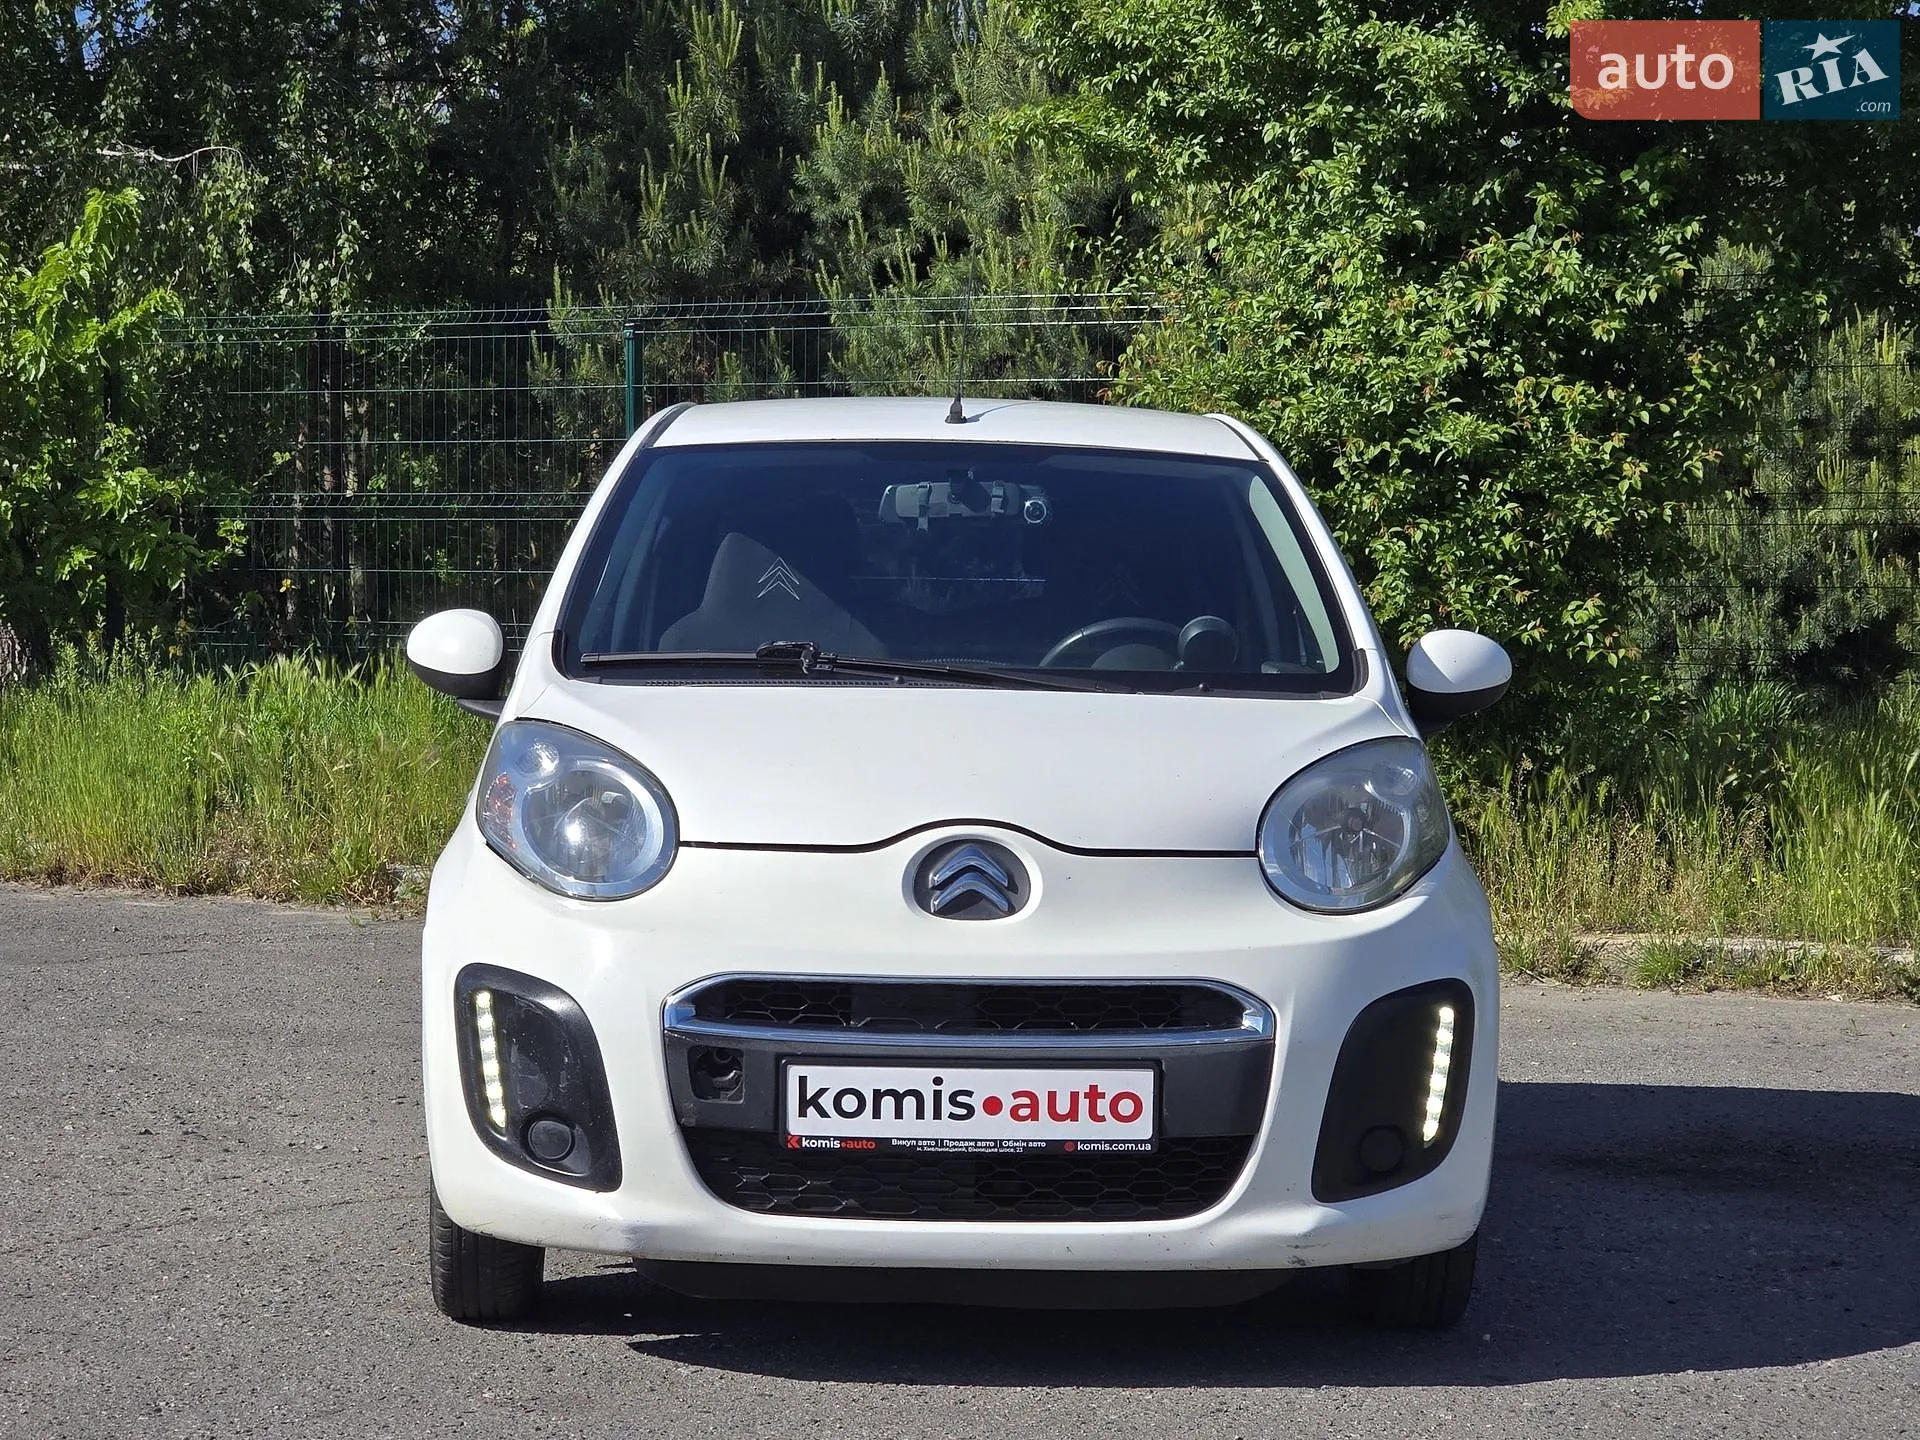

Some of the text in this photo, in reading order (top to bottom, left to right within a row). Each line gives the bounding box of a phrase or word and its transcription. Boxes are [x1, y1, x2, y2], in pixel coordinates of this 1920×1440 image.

[891, 1139, 916, 1147] Викуп
[943, 1139, 976, 1148] Продаж
[1077, 1141, 1152, 1151] komis.com.ua
